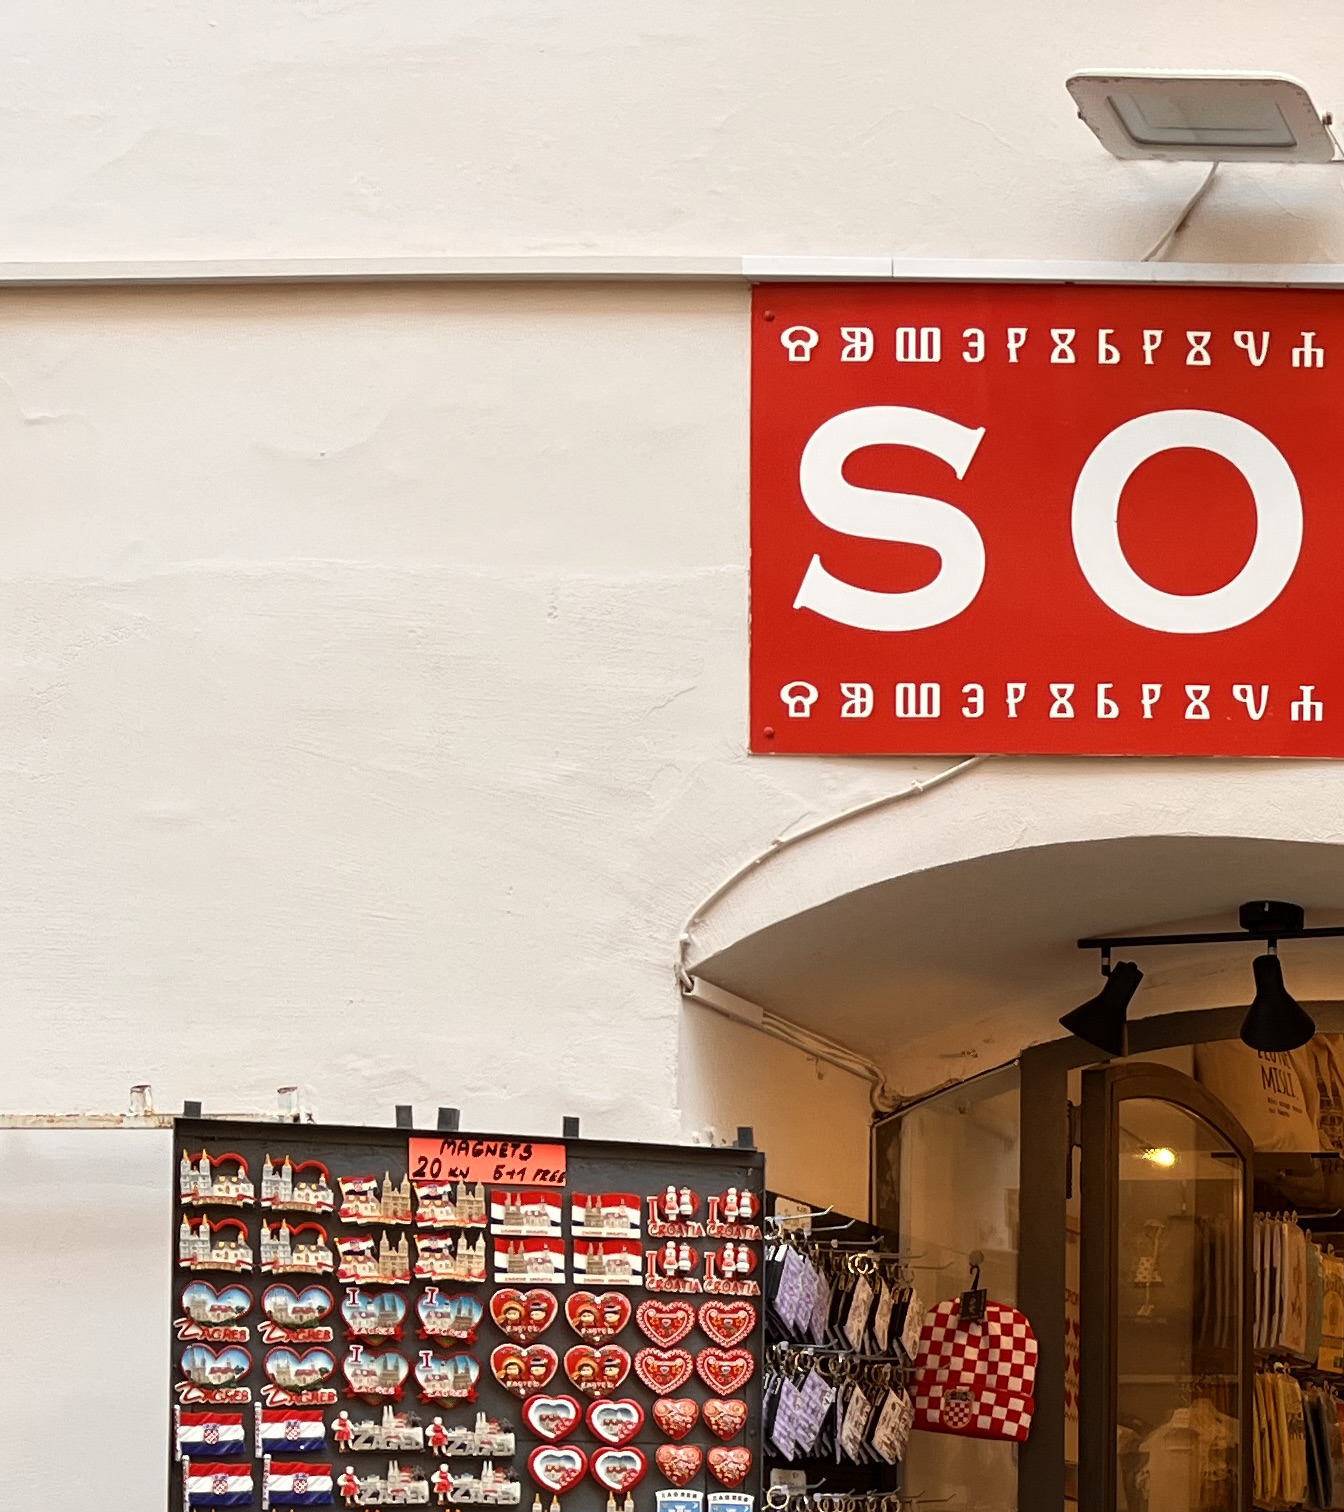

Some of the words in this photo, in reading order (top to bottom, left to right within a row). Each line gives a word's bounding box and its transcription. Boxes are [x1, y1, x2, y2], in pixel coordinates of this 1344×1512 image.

[440, 1138, 533, 1161] MAGNETS
[412, 1156, 442, 1178] 20
[648, 1220, 706, 1238] CROATIA
[706, 1220, 762, 1240] CROATIA
[645, 1275, 703, 1293] CROATIA
[703, 1277, 761, 1296] CROATIA
[174, 1318, 250, 1342] ZAGREB
